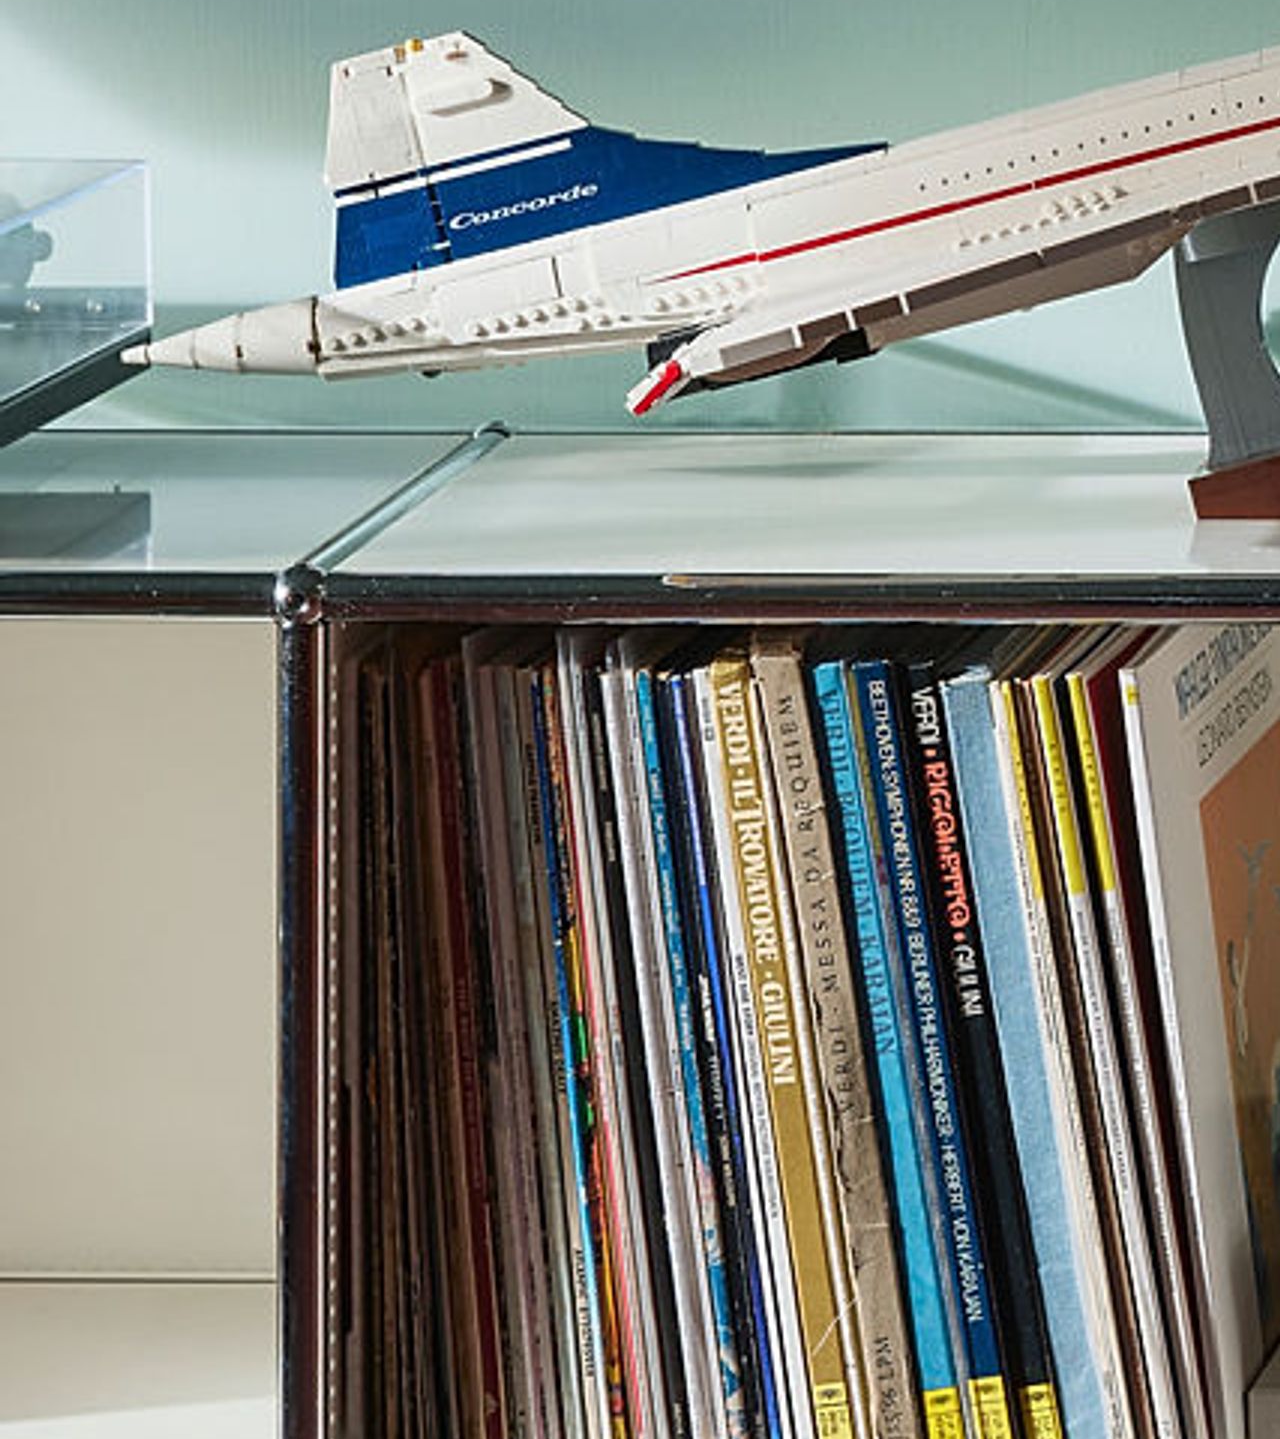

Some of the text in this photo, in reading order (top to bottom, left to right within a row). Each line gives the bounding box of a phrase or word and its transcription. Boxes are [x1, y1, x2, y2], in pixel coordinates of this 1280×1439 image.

[449, 183, 599, 230] Concorde
[717, 680, 750, 765] VERDI
[908, 685, 943, 746] VERDI
[732, 778, 757, 805] IL
[820, 689, 851, 774] VERDI
[838, 791, 875, 917] REQUIEM
[925, 761, 973, 928] RIGOLETTO
[777, 695, 857, 1113] VERDI MESSA DA REQUIEM
[761, 980, 796, 1086] GIULINI
[939, 1144, 965, 1213] HERBERT
[950, 1215, 971, 1249] VON
